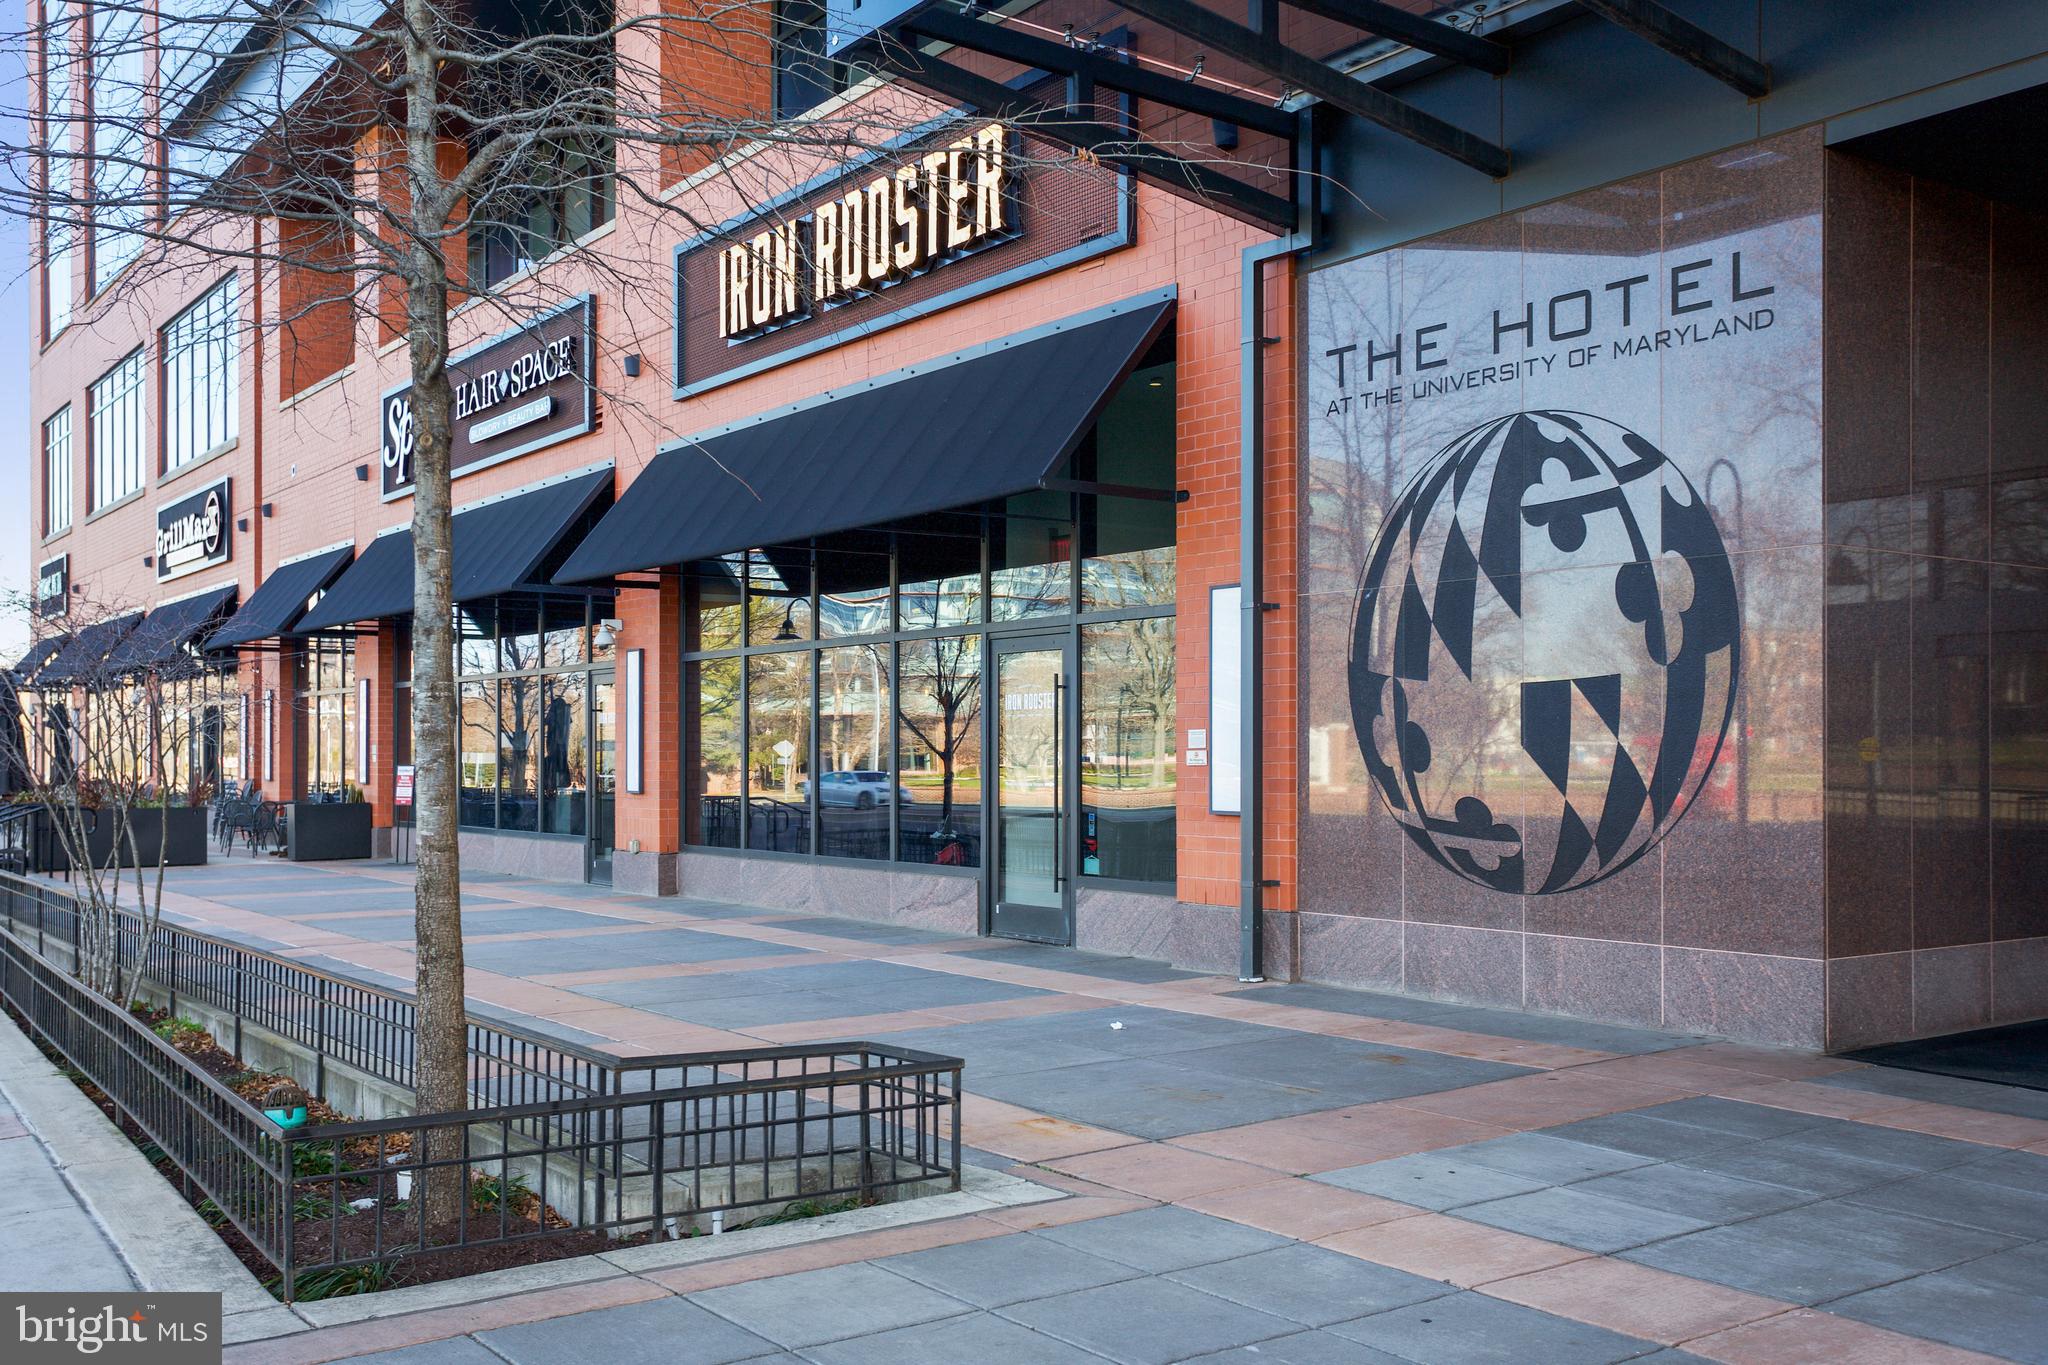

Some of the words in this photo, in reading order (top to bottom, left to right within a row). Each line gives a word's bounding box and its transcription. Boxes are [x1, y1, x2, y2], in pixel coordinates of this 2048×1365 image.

[719, 219, 797, 339] IRON
[815, 123, 1004, 301] ROOSTER
[1326, 322, 1448, 388] THE
[1493, 251, 1775, 355] HOTEL
[1326, 397, 1353, 417] AT
[1360, 387, 1402, 410] THE
[1412, 354, 1557, 399] UNIVERSITY
[1569, 345, 1602, 368] OF
[1613, 308, 1775, 360] MARYLAND
[455, 369, 500, 421] HAIR
[510, 336, 571, 398] SPACE
[507, 407, 534, 426] BEAUTY
[1005, 694, 1022, 710] IRON
